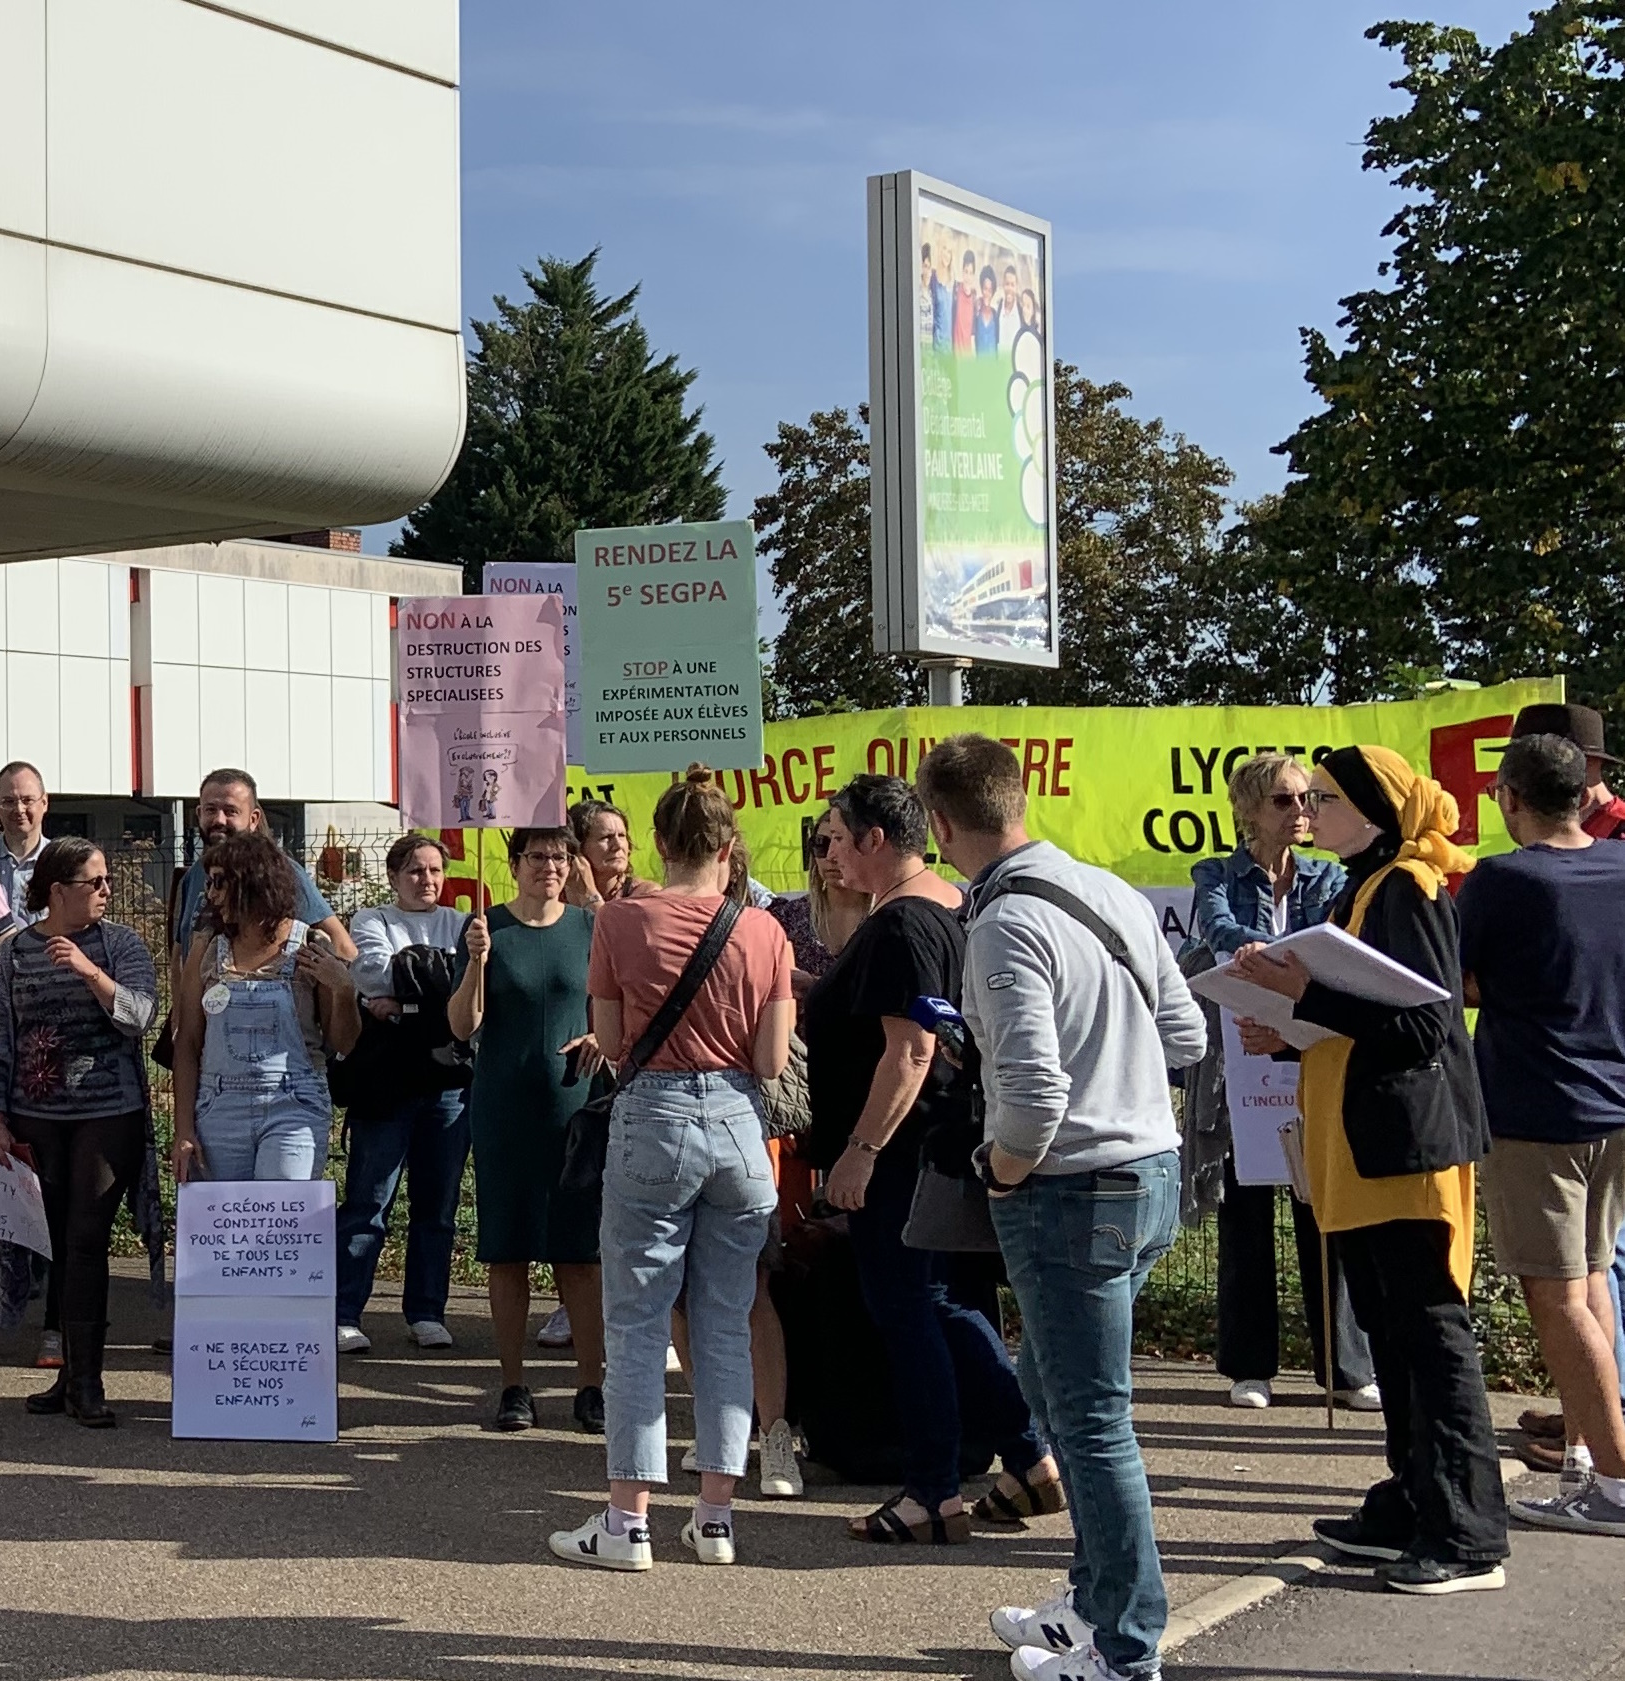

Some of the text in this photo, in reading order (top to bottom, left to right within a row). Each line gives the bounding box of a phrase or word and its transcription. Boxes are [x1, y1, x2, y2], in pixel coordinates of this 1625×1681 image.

[925, 449, 1004, 481] PAUL VERLAINE
[594, 538, 738, 567] RENDEZ LA
[490, 578, 564, 594] NON À LA
[640, 579, 728, 606] SEGPA
[407, 612, 493, 631] NON À LA
[407, 639, 542, 657] DESTRUCTION DES
[407, 665, 501, 680] STRUCTURES
[623, 659, 717, 677] STOP À UNE
[407, 688, 504, 703] SPECIALISEES
[602, 683, 739, 702] EXPÉRIMENTATION
[595, 702, 749, 723] IMPOSÉE AUX ÉLÈVES
[599, 728, 746, 745] ET AUX PERSONNELS
[1242, 1096, 1296, 1107] L'INCLU
[222, 1198, 305, 1213] CRÉONS LES
[213, 1218, 299, 1229] CONDITIONS
[190, 1230, 322, 1245] POUR LA RÉUSSITE
[214, 1250, 299, 1261] DE TOUS LES
[222, 1266, 283, 1277] ENFANTS
[206, 1342, 320, 1354] NE BRADEZ PAS
[208, 1356, 308, 1372] LA SÉCURITÉ
[233, 1378, 283, 1389] DE NOS
[215, 1395, 280, 1407] ENFANTS
